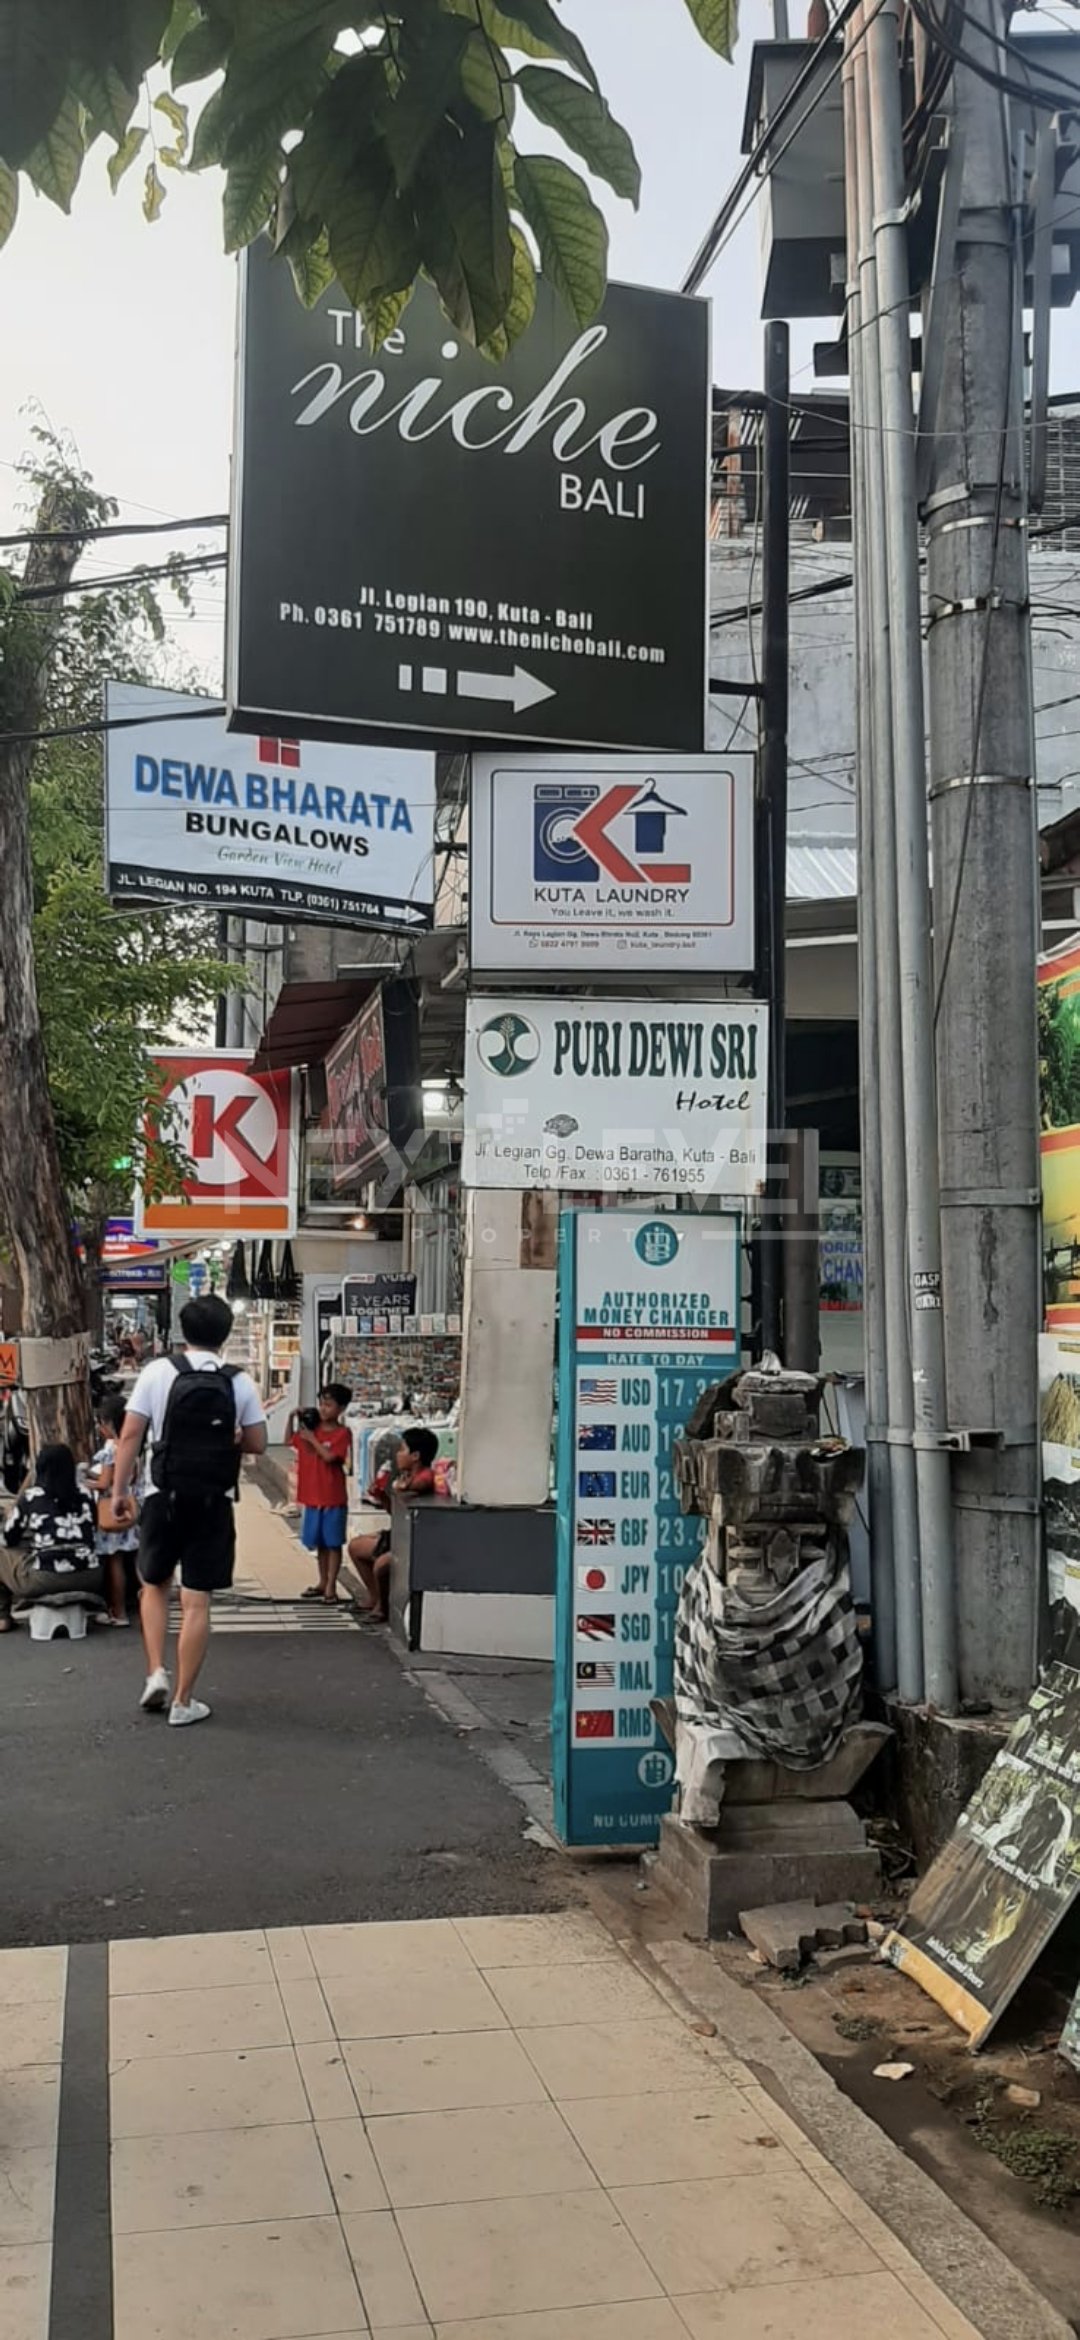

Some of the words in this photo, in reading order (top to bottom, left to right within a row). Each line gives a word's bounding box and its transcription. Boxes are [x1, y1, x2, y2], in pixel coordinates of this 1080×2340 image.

[290, 323, 661, 471] niche
[560, 473, 645, 519] BALI
[360, 586, 380, 607] Jl.
[385, 589, 450, 615] Legian
[455, 598, 493, 621] 190,
[498, 603, 541, 624] Kuta
[556, 609, 593, 631] Bali
[280, 602, 309, 624] Ph.
[314, 606, 362, 630] 0361
[374, 612, 440, 638] 751789
[448, 623, 666, 663] www.thenichebali.com
[134, 754, 239, 806] DEWA
[245, 772, 413, 834] BHARATA
[186, 811, 370, 857] BUNGALOWS
[217, 845, 268, 865] Garden
[308, 857, 343, 876] Hotel
[117, 874, 136, 886] JL.
[138, 875, 185, 892] LEGIAN
[187, 883, 212, 896] NO.
[214, 884, 237, 895] 194
[240, 885, 275, 899] KUTA
[280, 888, 305, 903] TLP.
[307, 893, 340, 911] (0361)
[534, 888, 585, 903] KUTA
[596, 888, 690, 904] LAUNDRY
[551, 907, 571, 917] You
[573, 907, 603, 917] Leave
[618, 909, 634, 917] we
[636, 908, 662, 917] wash
[554, 1021, 622, 1077] PURI
[628, 1022, 704, 1080] DEWI
[710, 1023, 758, 1080] SRI
[676, 1090, 751, 1112] Hotel
[494, 1145, 541, 1162] Legian
[574, 1146, 614, 1161] Dewa
[619, 1146, 678, 1163] Baratha,
[683, 1149, 715, 1163] Kuta
[729, 1149, 756, 1164] Bali
[603, 1167, 638, 1181] 0361
[653, 1168, 706, 1183] 761955
[350, 1295, 359, 1307] 3
[363, 1293, 411, 1308] YEARS
[350, 1306, 410, 1316] TOGETHER
[602, 1291, 711, 1310] AUTHORIZED
[584, 1307, 643, 1325] MONEY
[649, 1309, 730, 1326] CHANGER
[603, 1327, 621, 1338] NO
[624, 1327, 709, 1339] COMMISSION
[607, 1353, 646, 1365] RATE
[651, 1354, 671, 1366] TO
[676, 1355, 705, 1367] DAY
[621, 1378, 651, 1406] USD
[621, 1424, 650, 1453] AUD
[621, 1471, 650, 1499] EUR
[621, 1565, 650, 1594] JPY
[621, 1613, 651, 1642] SGD
[619, 1661, 652, 1690] MAL
[618, 1708, 651, 1737] RMB
